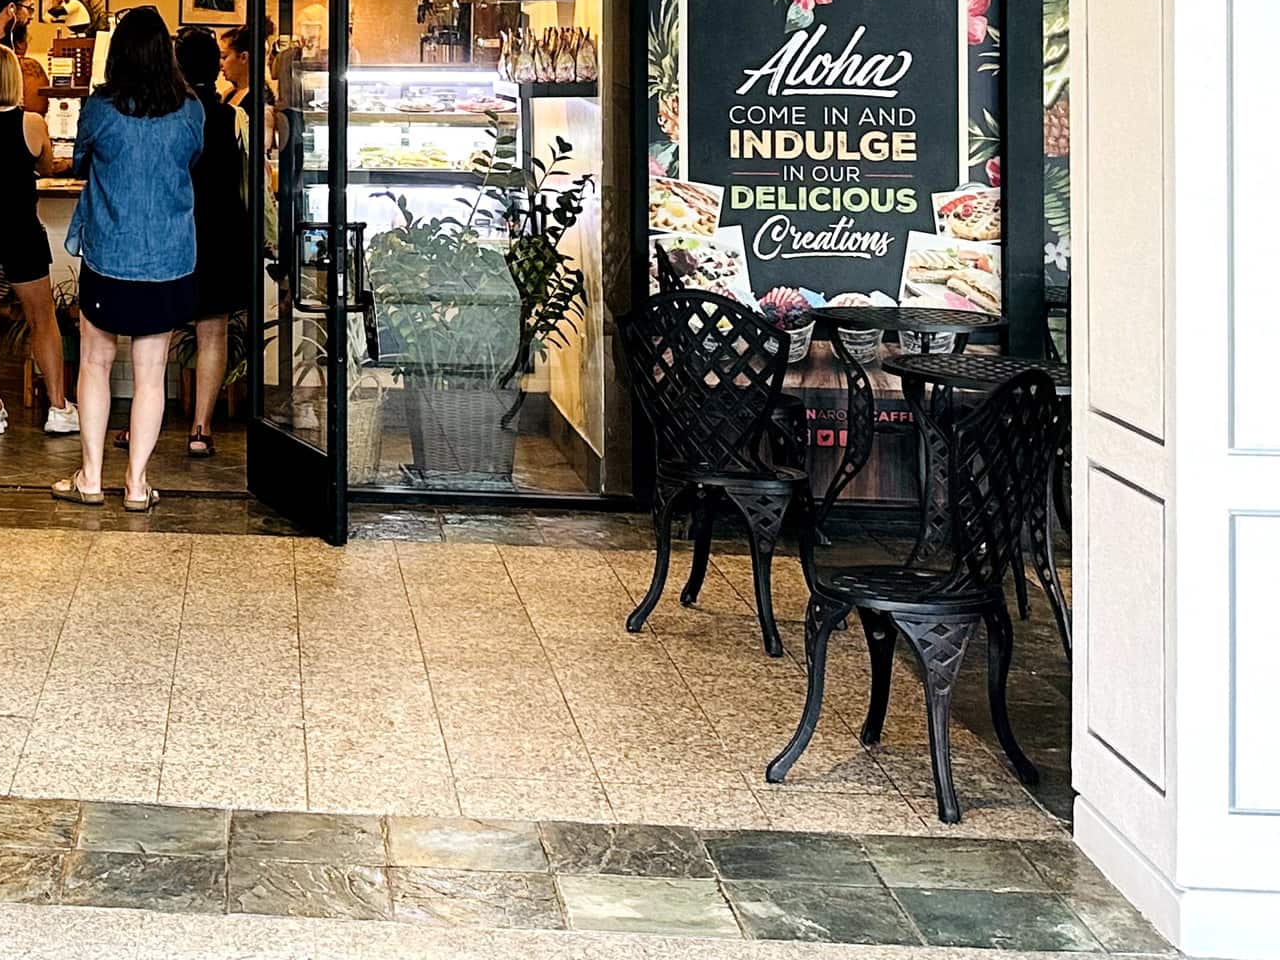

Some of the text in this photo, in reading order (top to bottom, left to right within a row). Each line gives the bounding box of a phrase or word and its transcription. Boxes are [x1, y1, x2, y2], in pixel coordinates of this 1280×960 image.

[735, 24, 911, 98] Aloha
[729, 106, 916, 127] COME IN AND
[729, 130, 918, 161] INDULGE
[783, 165, 860, 182] IN OUR
[730, 186, 918, 213] DELICIOUS
[752, 214, 896, 260] Creations
